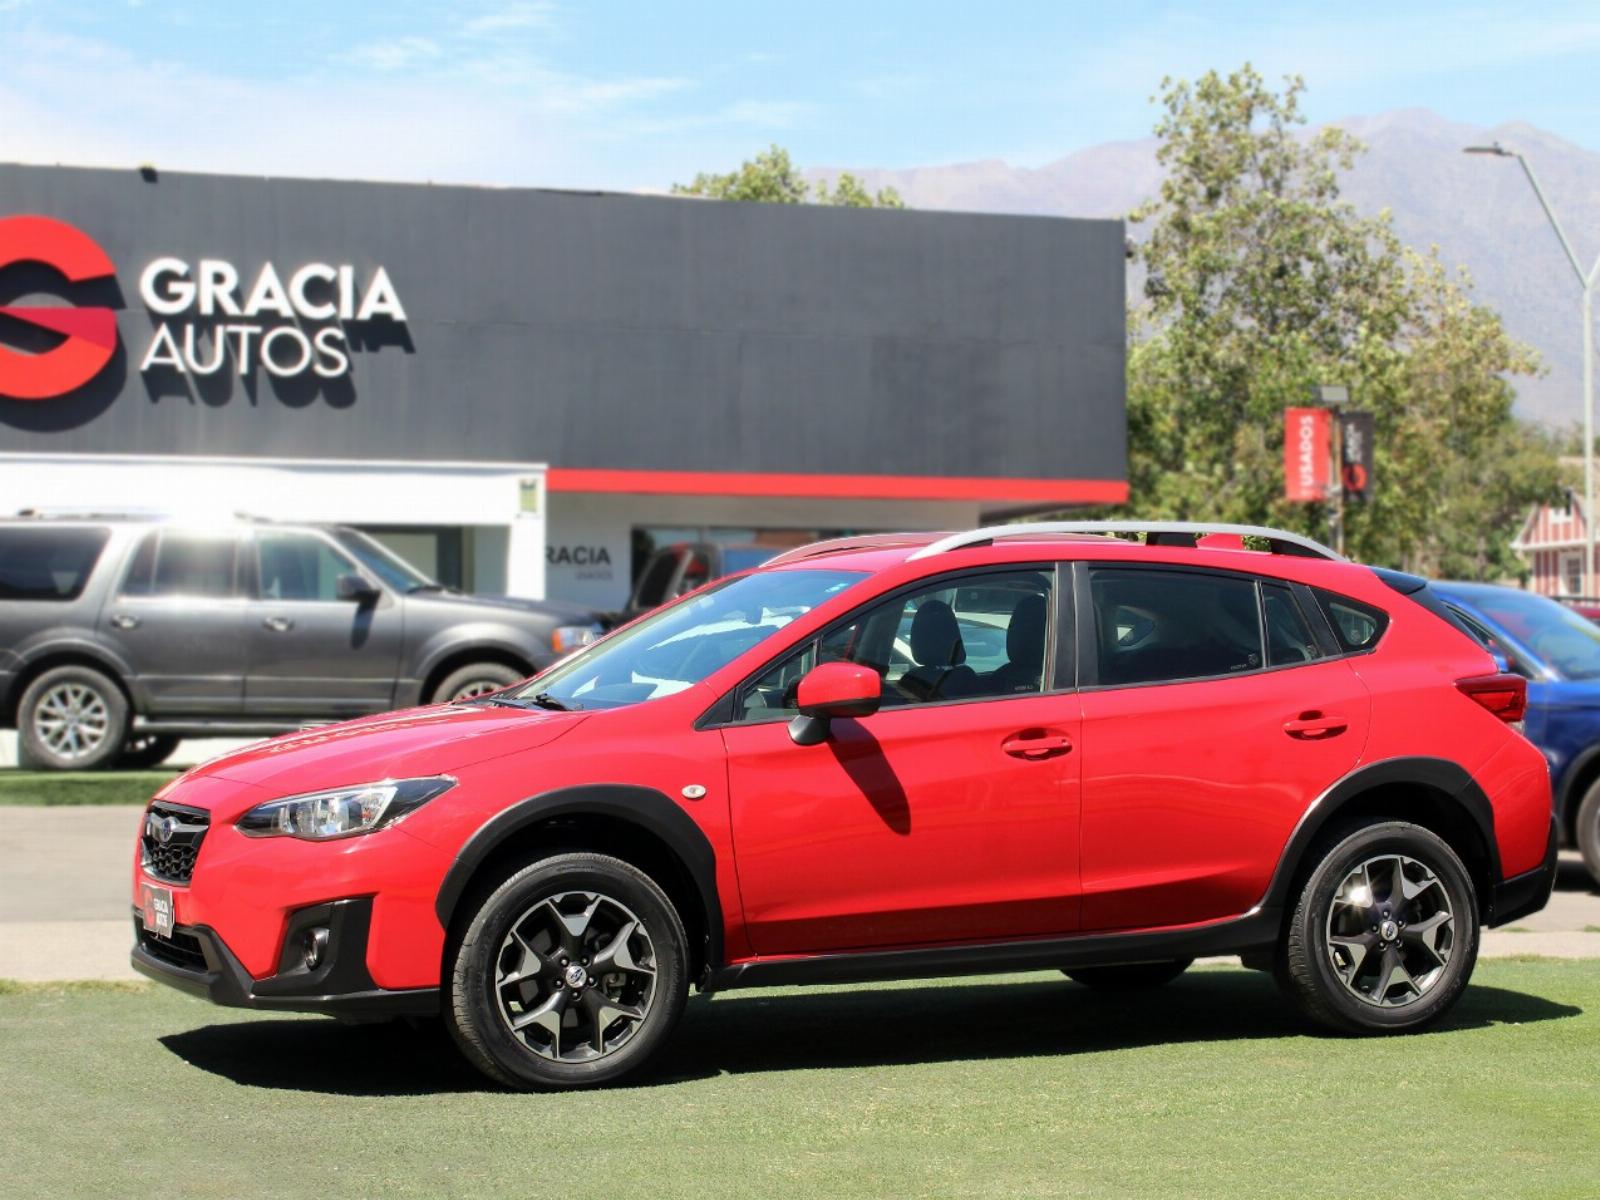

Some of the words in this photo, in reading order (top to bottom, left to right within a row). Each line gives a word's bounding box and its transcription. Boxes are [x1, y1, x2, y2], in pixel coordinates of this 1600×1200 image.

[139, 257, 407, 321] GRACIA
[140, 323, 349, 377] AUTOS
[1299, 415, 1315, 486] USADOS
[546, 546, 611, 566] RACIA
